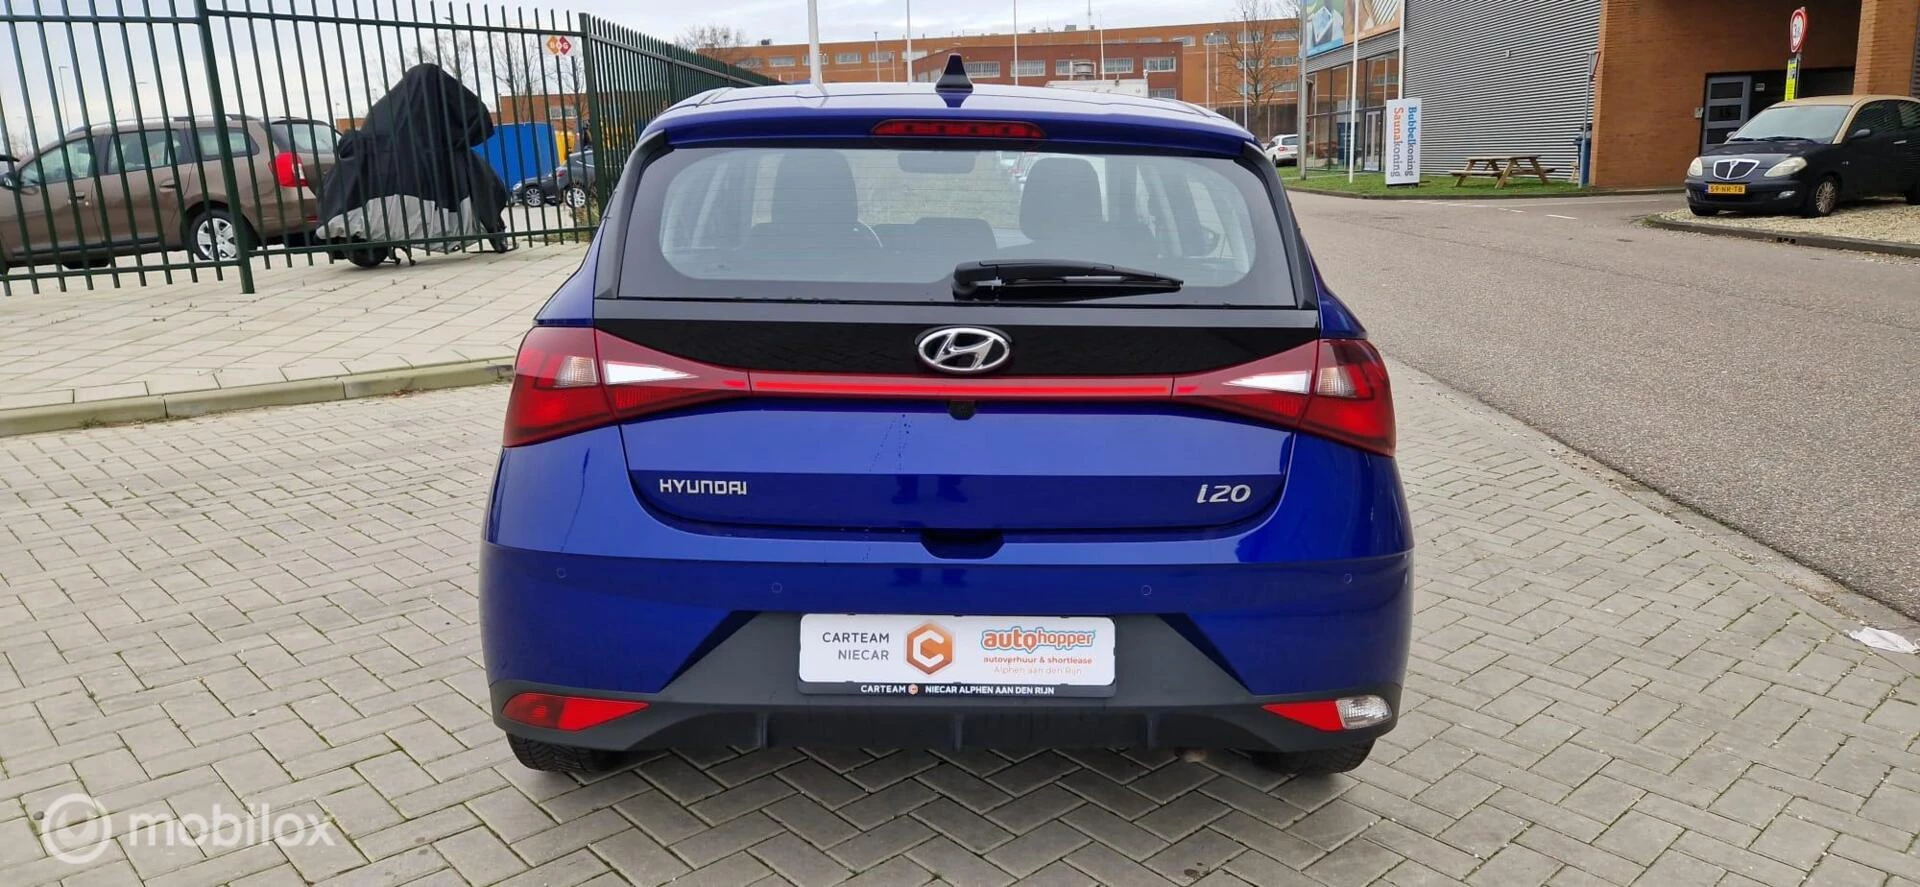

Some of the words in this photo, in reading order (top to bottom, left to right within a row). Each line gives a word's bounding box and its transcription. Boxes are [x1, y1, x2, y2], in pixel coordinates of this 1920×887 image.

[1391, 107, 1404, 177] Saunakoning
[1405, 106, 1417, 177] Bubbelkoning
[659, 479, 747, 495] HYUNDAI
[1197, 484, 1251, 503] i20
[822, 632, 890, 643] CARTEAM
[983, 629, 1093, 651] autohopper
[838, 650, 889, 660] NIECAR
[983, 656, 1037, 664] autoverhuur
[1047, 656, 1093, 664] shortlease
[993, 666, 1026, 675] Alphen
[1045, 666, 1062, 674] den
[1065, 667, 1082, 676] Rijn
[860, 685, 906, 693] CARTEAM
[925, 685, 957, 693] NIECAR
[958, 686, 993, 694] ALPHEN
[995, 686, 1013, 694] AAN
[1015, 686, 1033, 694] DEN
[1035, 686, 1055, 694] RIJN
